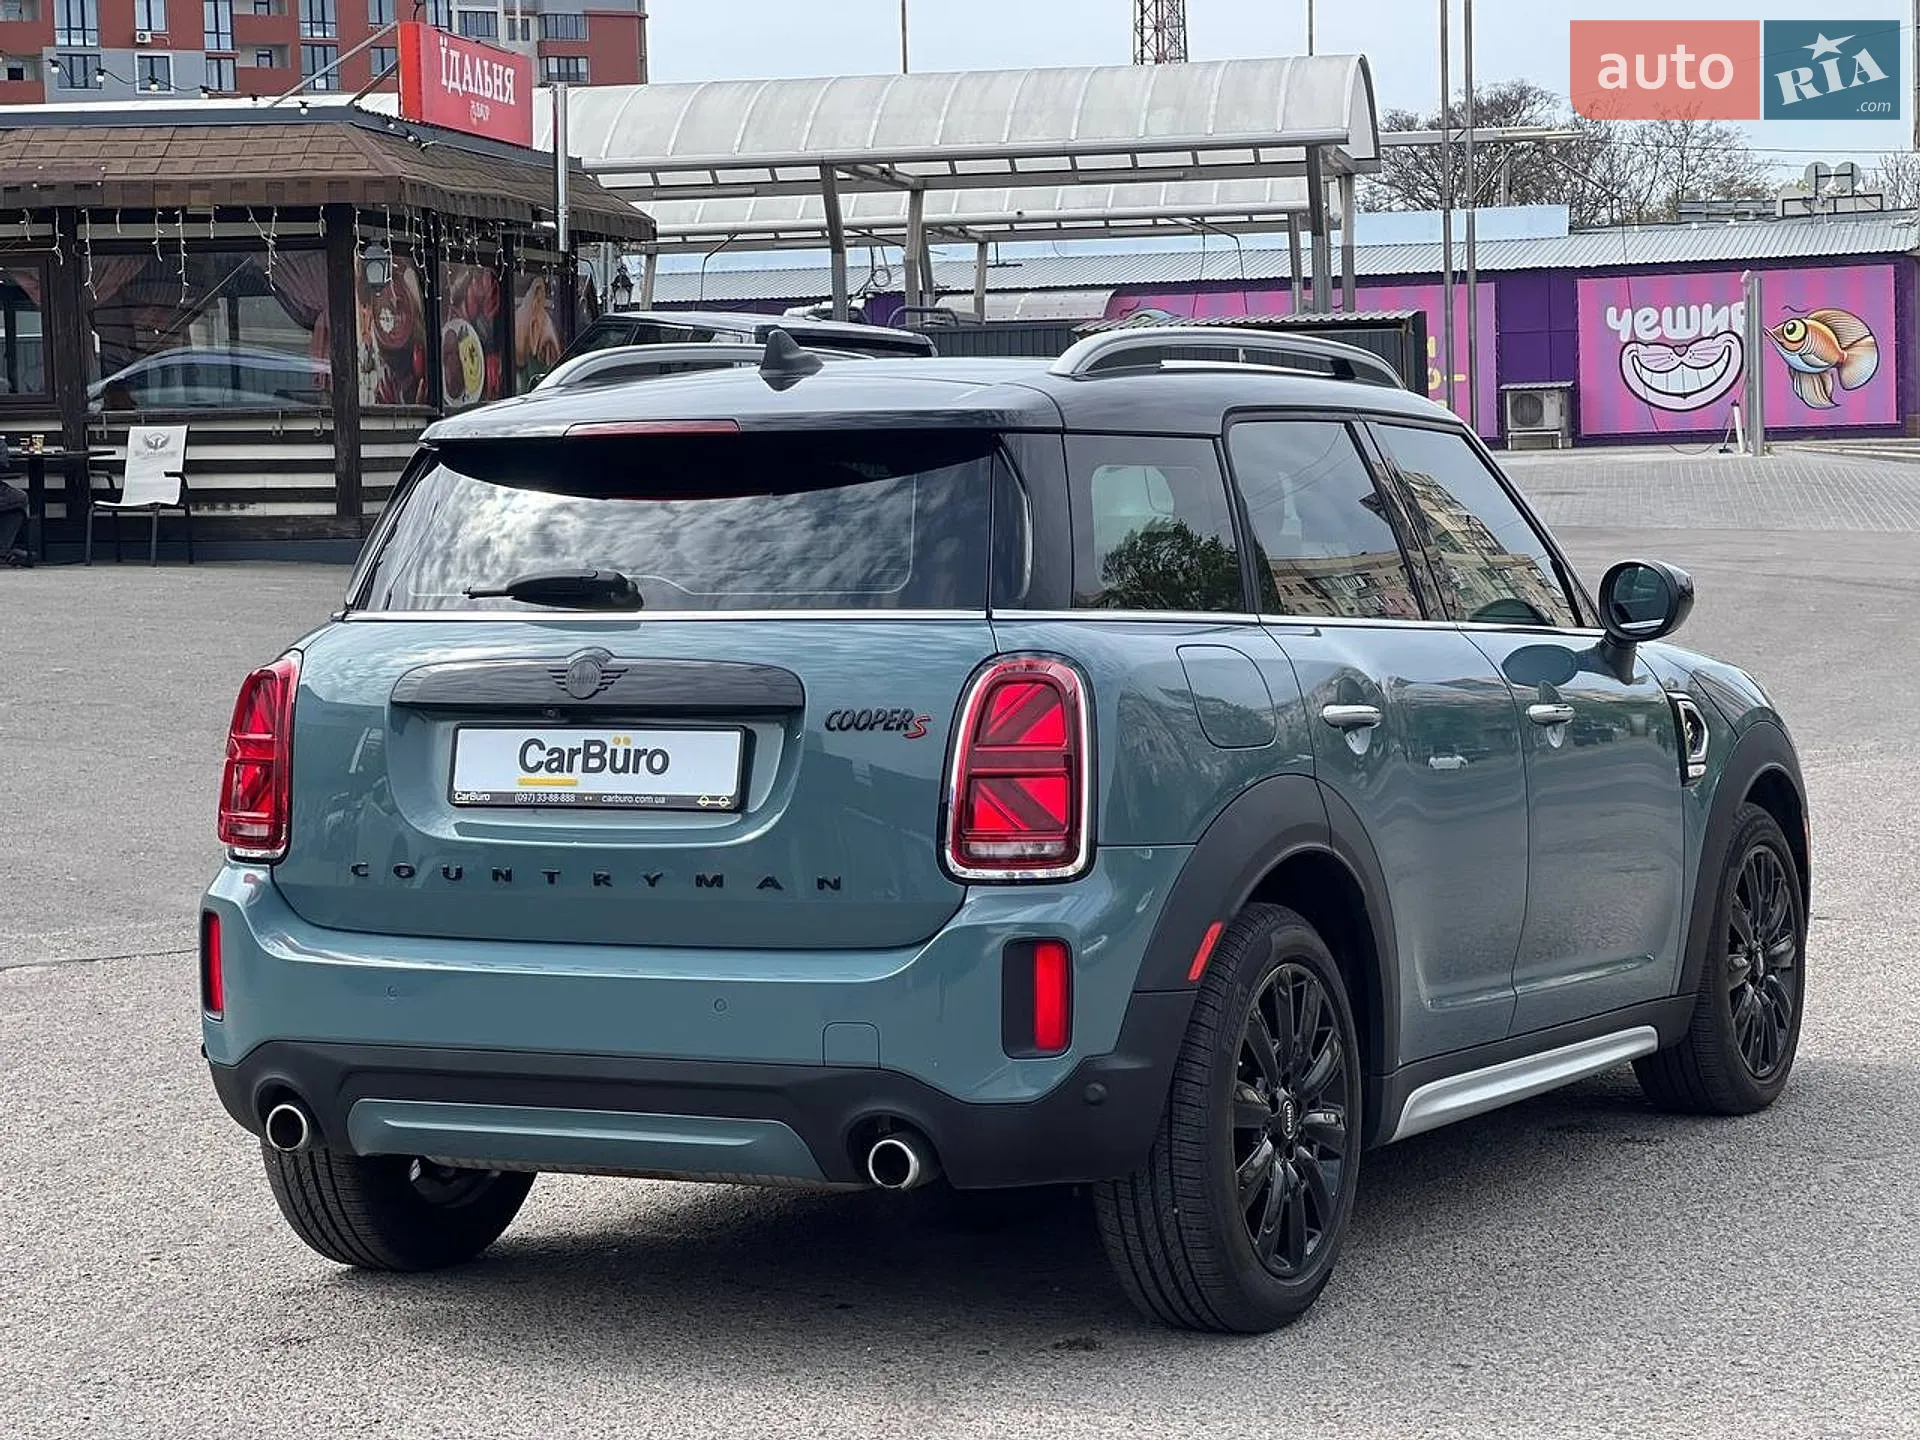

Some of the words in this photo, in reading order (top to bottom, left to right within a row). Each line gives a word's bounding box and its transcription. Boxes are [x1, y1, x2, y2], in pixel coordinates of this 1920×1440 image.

[440, 36, 516, 105] ЇДАЛЬНЯ
[825, 708, 915, 732] COOPER
[518, 736, 671, 775] CarBüro
[351, 862, 843, 891] COUNTRYMAN
